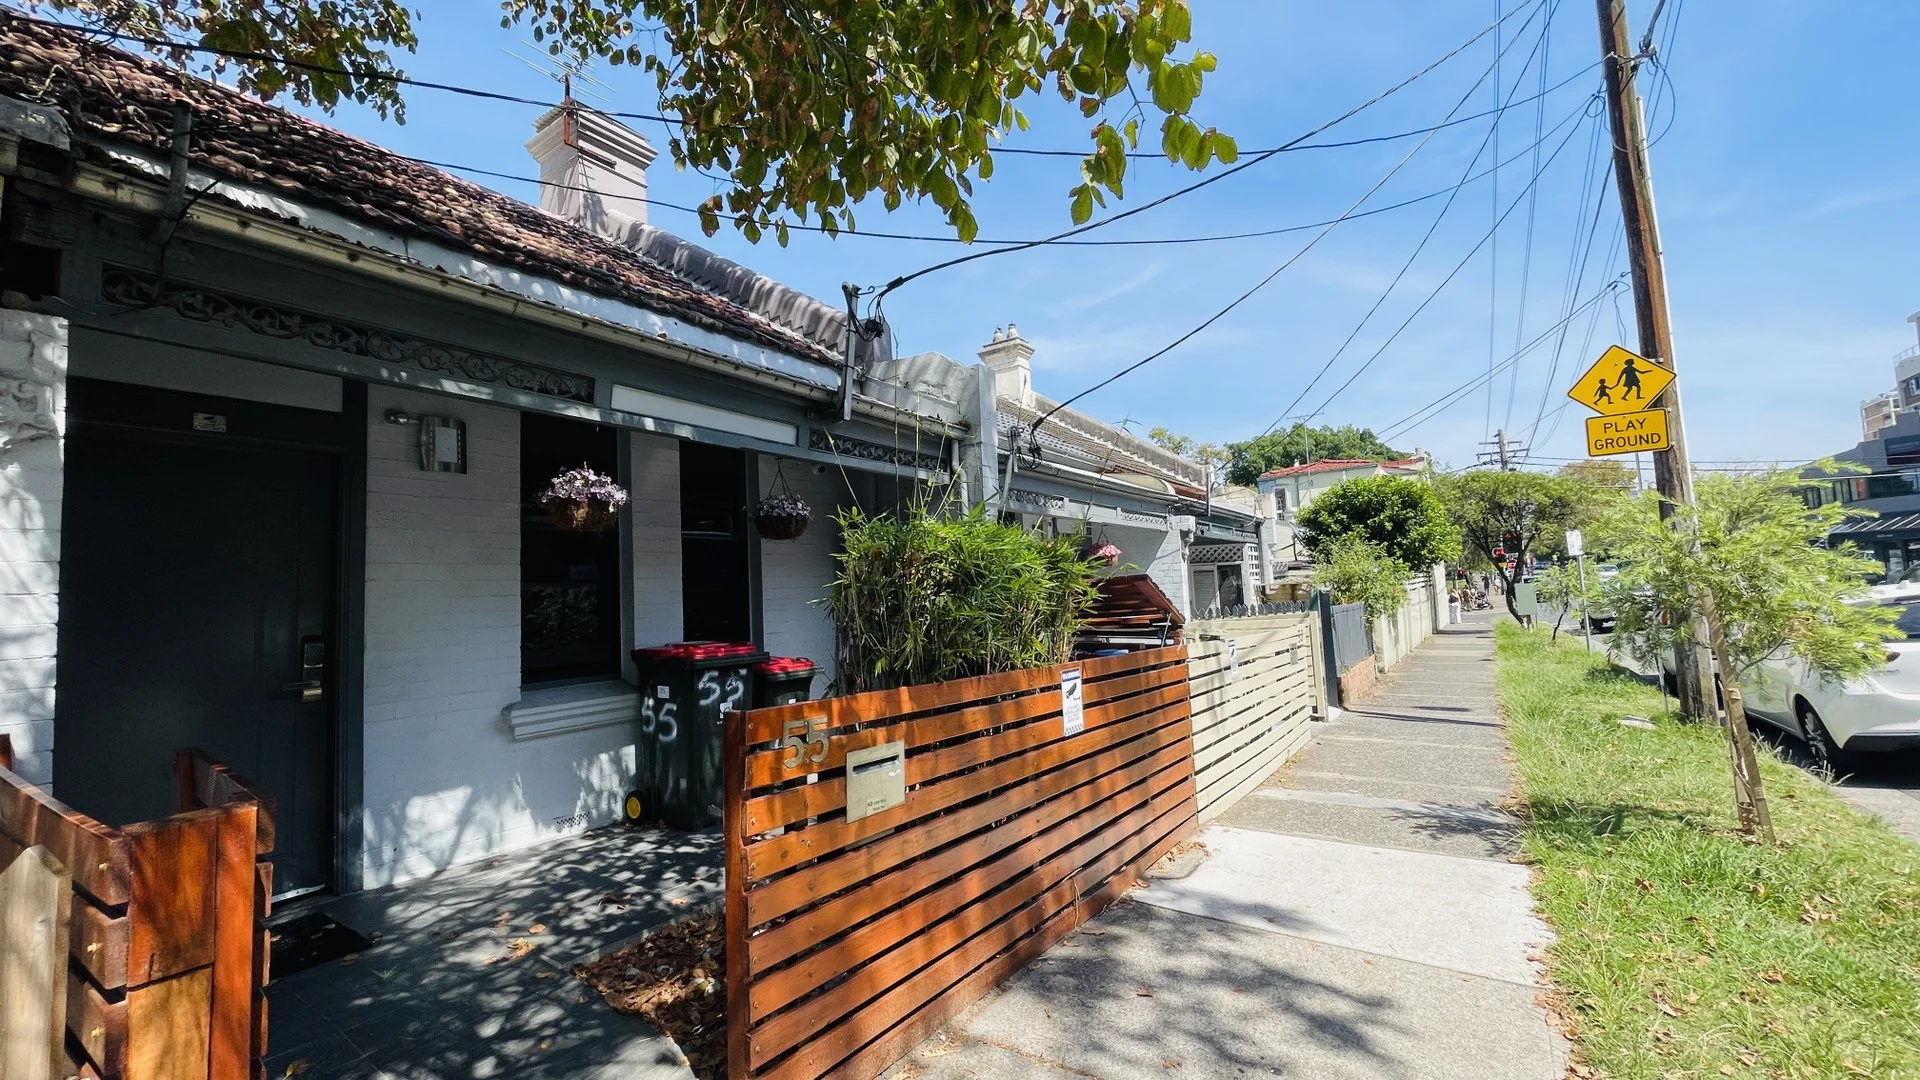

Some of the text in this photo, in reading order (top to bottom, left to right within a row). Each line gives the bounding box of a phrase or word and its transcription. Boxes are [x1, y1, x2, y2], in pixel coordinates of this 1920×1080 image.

[1594, 432, 1661, 451] GROUND
[1603, 418, 1647, 434] PLAY
[641, 696, 678, 741] 55
[782, 714, 829, 769] 55
